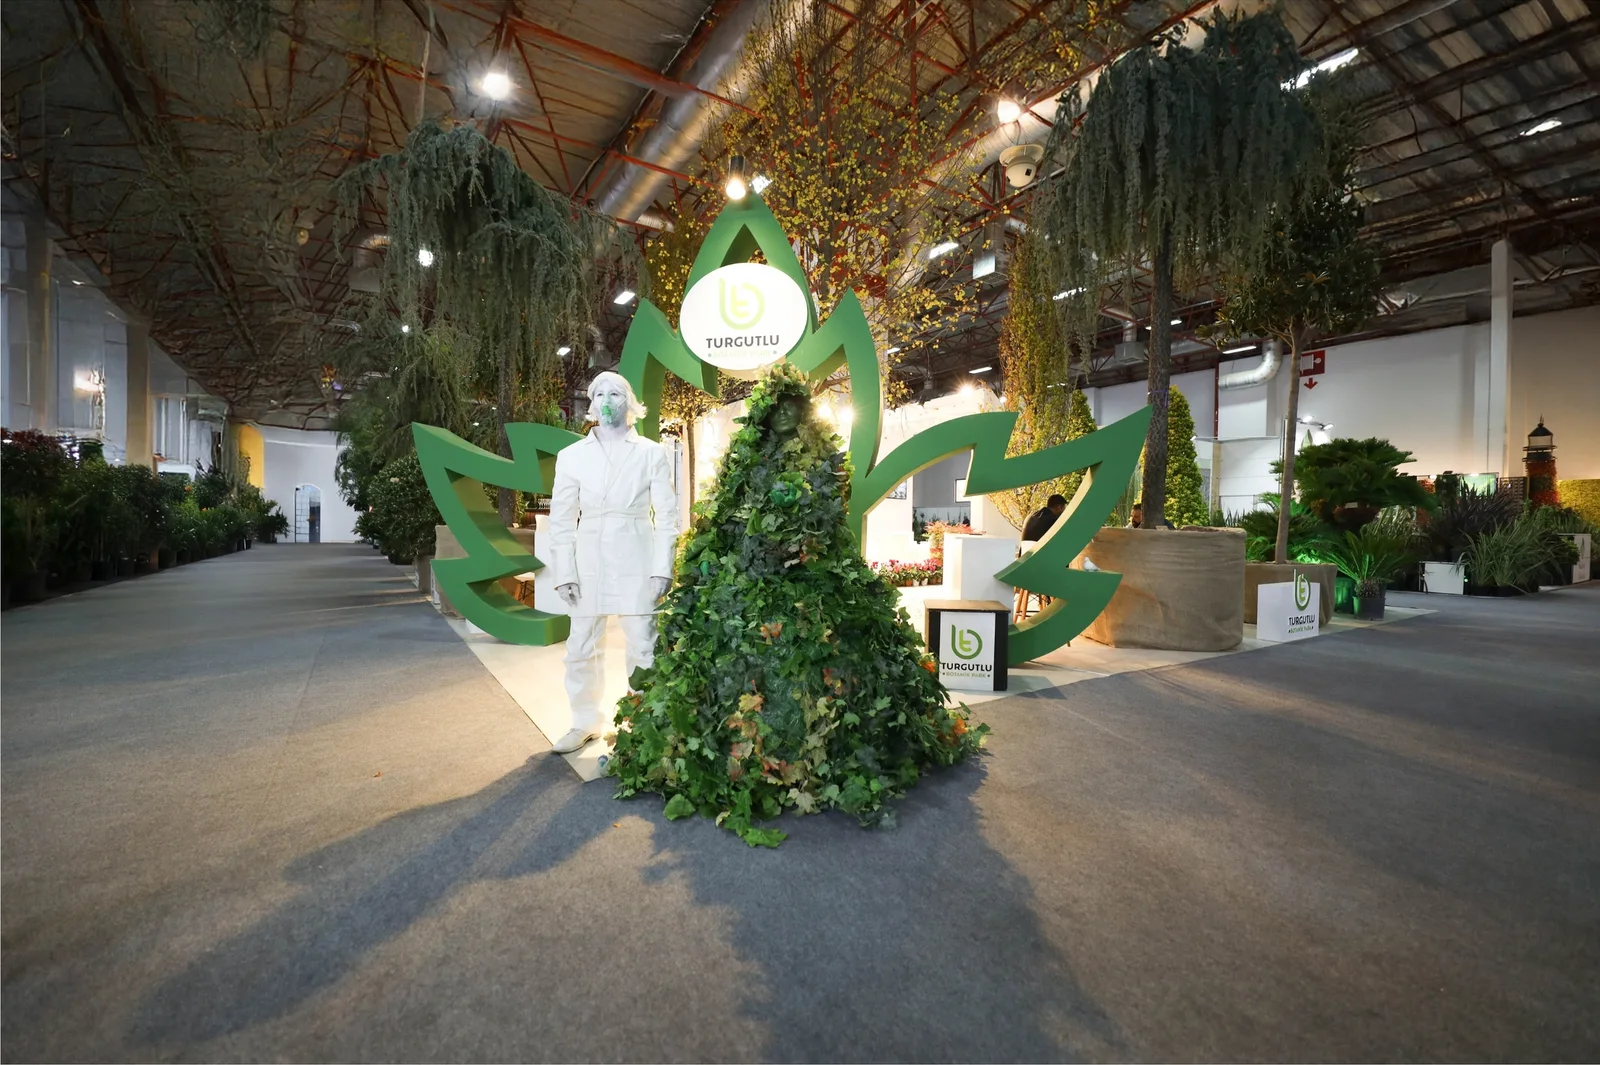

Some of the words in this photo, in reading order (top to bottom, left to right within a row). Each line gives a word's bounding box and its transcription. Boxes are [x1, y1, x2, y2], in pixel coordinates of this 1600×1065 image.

[706, 335, 779, 348] TURGUTLU
[1289, 614, 1315, 625] TURGUTLU
[941, 662, 992, 672] TURGUTLU
